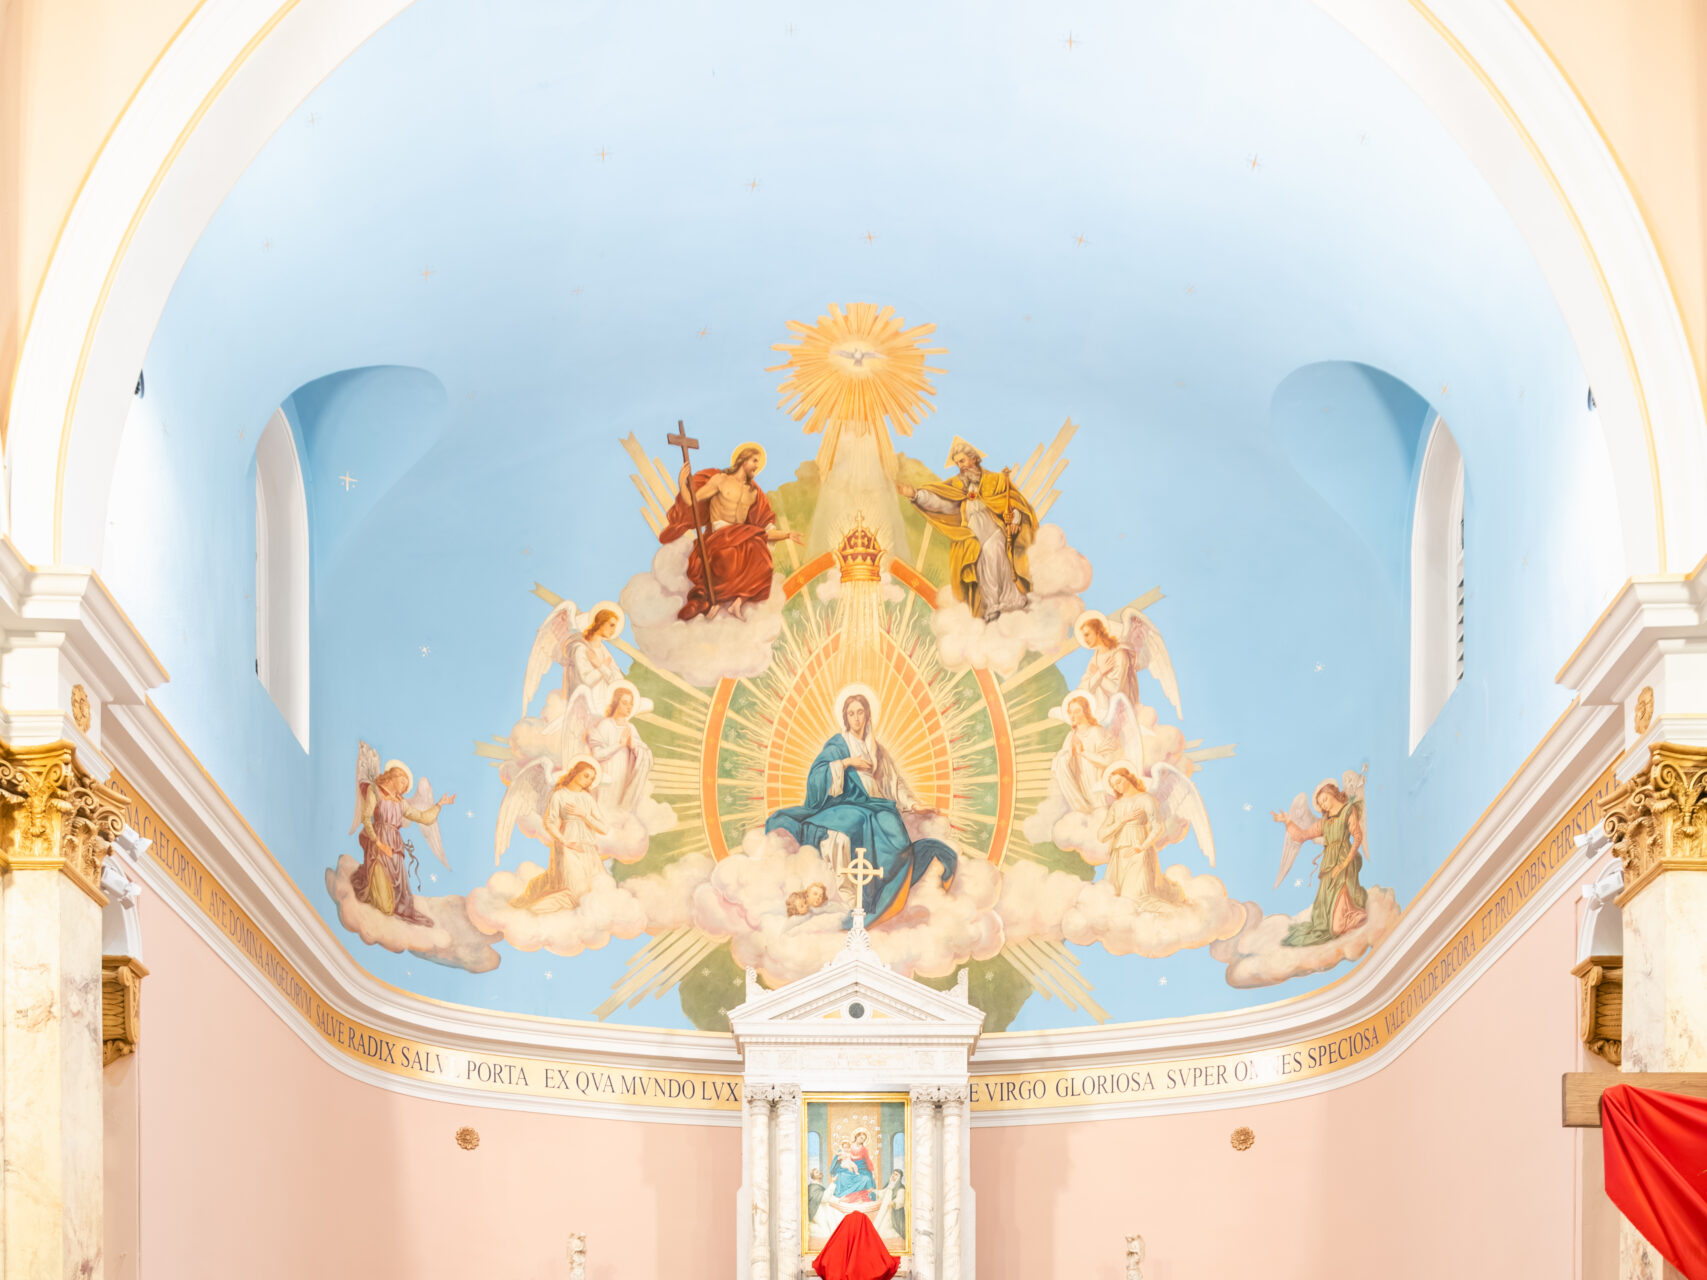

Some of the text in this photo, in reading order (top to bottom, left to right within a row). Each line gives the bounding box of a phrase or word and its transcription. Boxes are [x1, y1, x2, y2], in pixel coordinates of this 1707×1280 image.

[143, 815, 739, 1102] CAELORVM AVE DOMINA ANGELORVM SALVE RADIX SALV PORTA EX QVA MVNDO LVX
[985, 1079, 1047, 1102] VIRGO
[1055, 1071, 1156, 1098] GLORIOSA
[1167, 1064, 1229, 1090] SVPER
[1308, 1025, 1379, 1069] SPECIOSA
[1385, 1000, 1406, 1036] VALE
[1413, 965, 1439, 1008] VALDE
[1440, 930, 1476, 985] DECORA
[1481, 908, 1493, 943] ET
[1495, 888, 1514, 929] PRO
[1515, 851, 1547, 907] NOBIS
